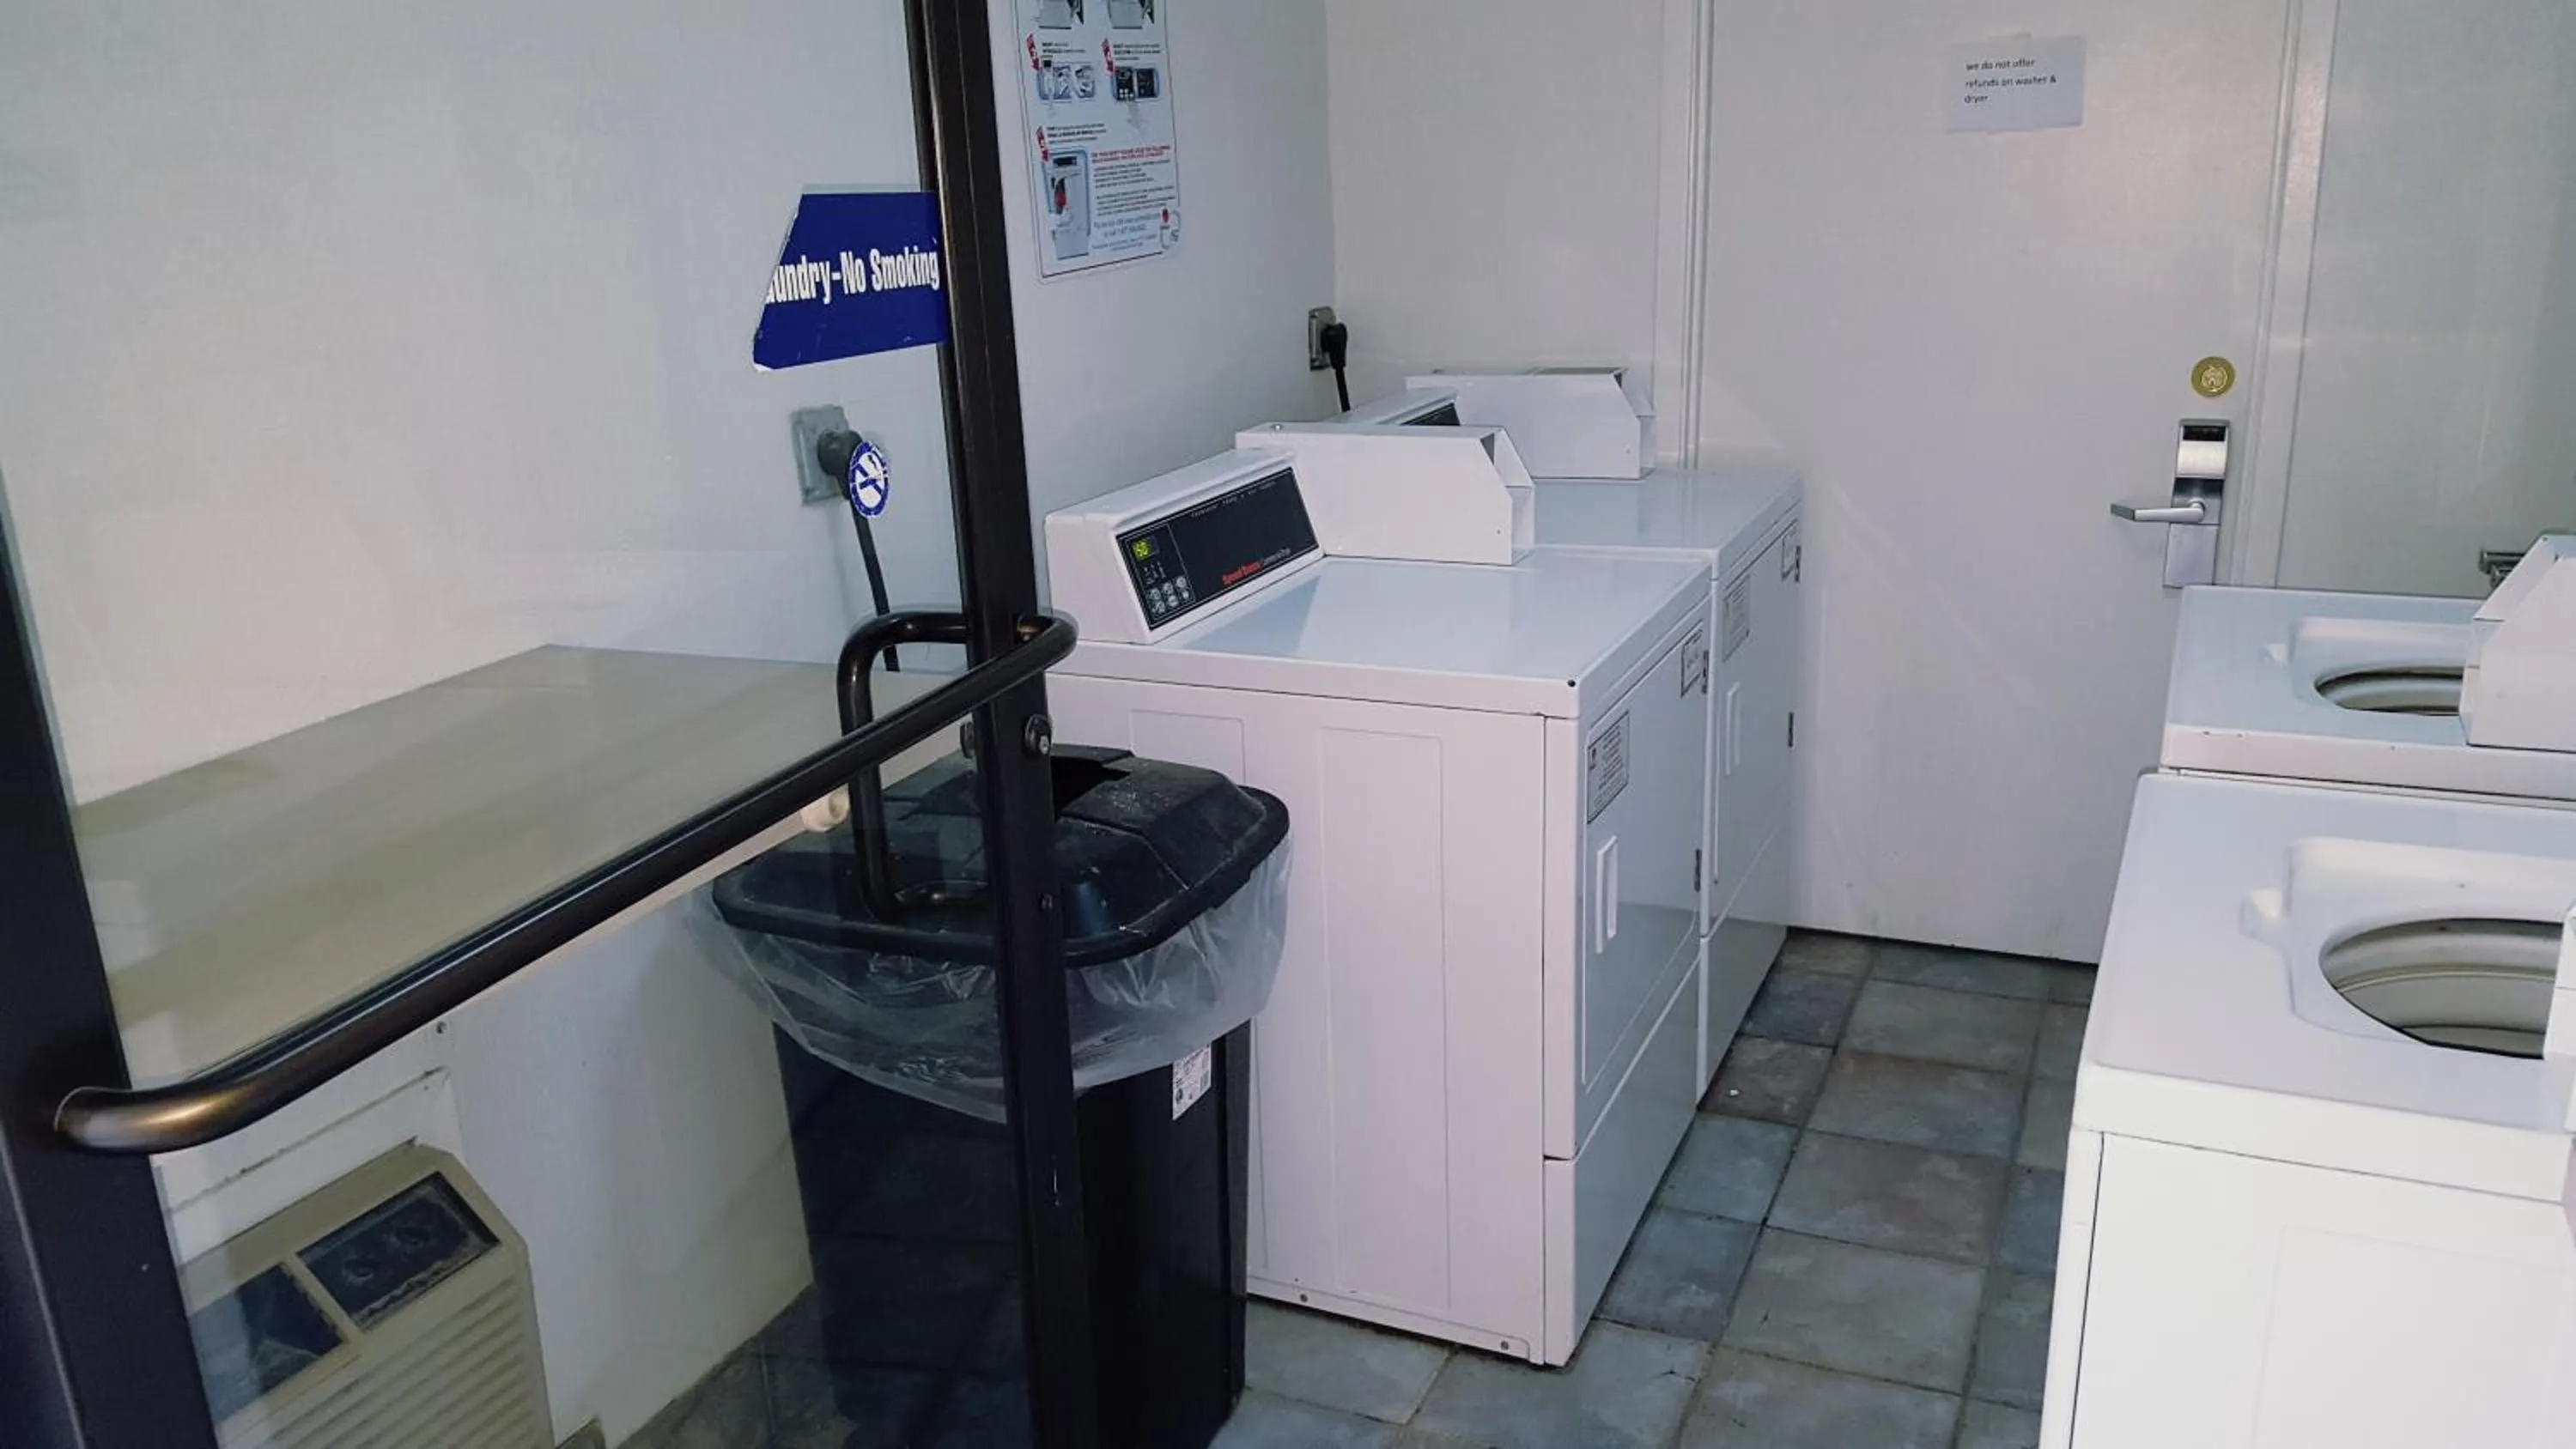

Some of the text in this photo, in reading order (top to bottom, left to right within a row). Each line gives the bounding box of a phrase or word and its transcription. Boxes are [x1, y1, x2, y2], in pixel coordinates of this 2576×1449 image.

[1981, 60, 1993, 70] do
[1995, 59, 2011, 70] not
[2012, 58, 2035, 68] offer
[1965, 77, 2000, 88] refunds
[2001, 78, 2014, 87] on
[2015, 75, 2048, 86] washer
[1964, 94, 1989, 104] dryer
[869, 246, 940, 291] Smoking
